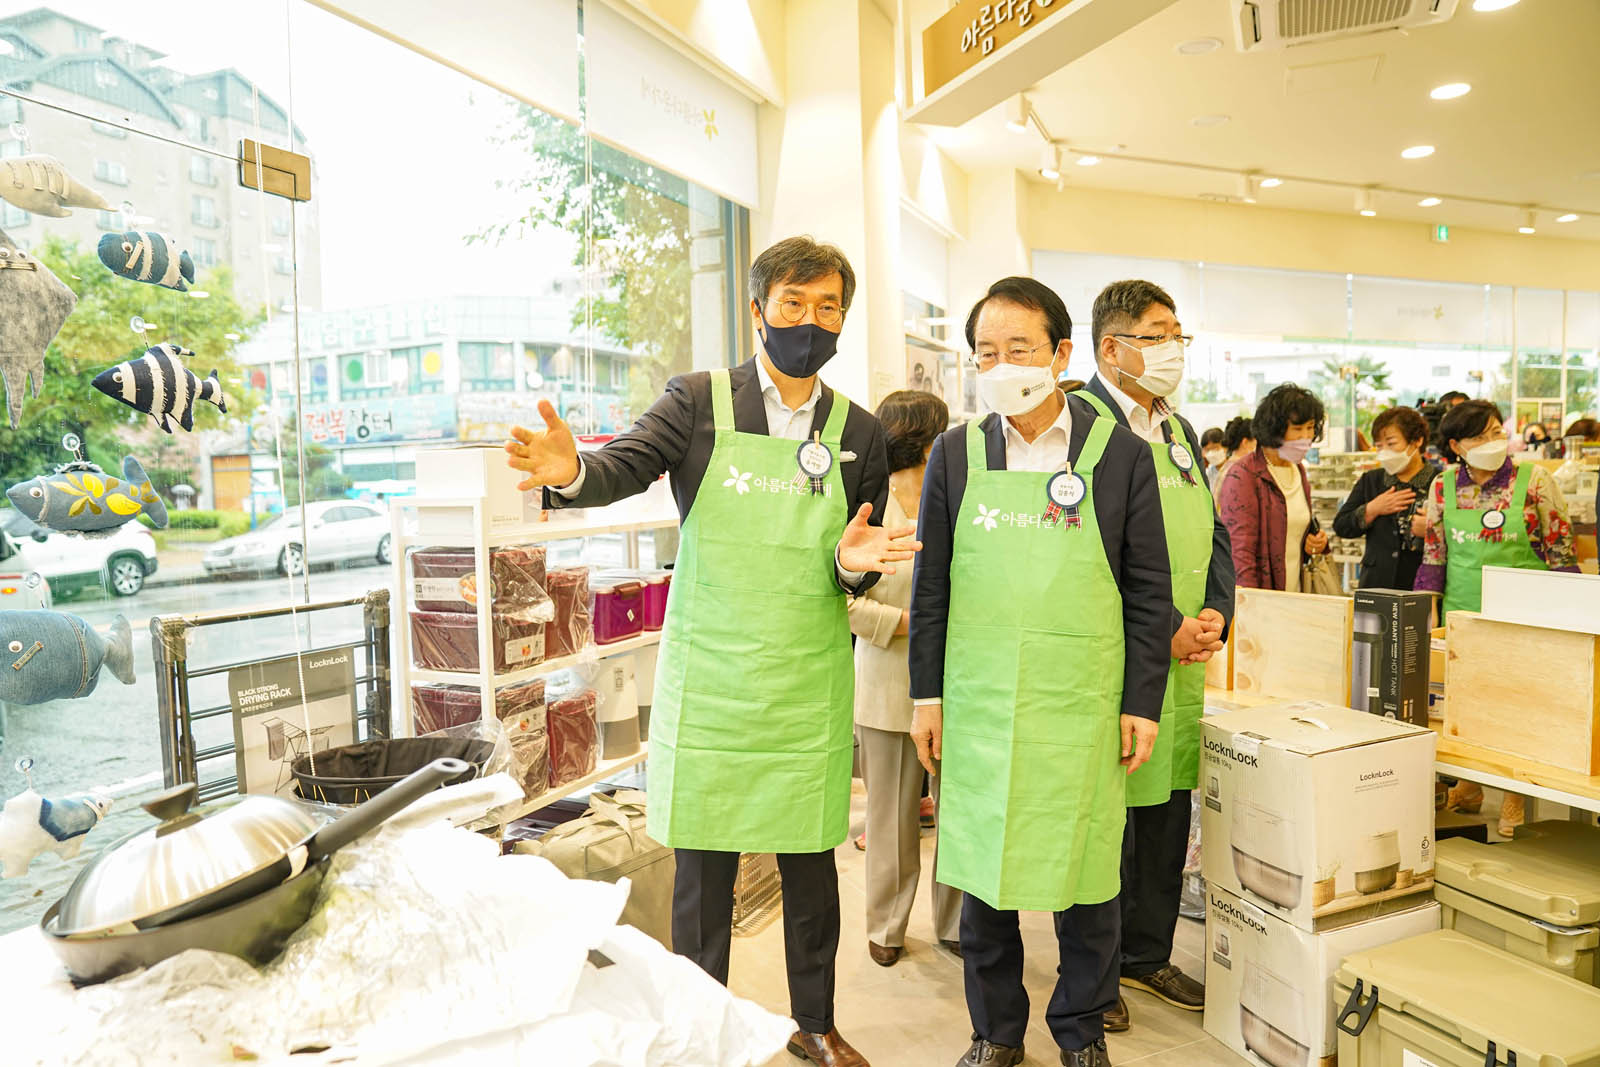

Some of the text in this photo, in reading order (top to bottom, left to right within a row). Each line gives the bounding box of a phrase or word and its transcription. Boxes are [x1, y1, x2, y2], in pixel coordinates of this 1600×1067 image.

[304, 407, 393, 442] 전복 장터
[309, 655, 348, 669] LocknLock
[237, 683, 279, 698] BLACK STRONG
[239, 687, 292, 706] DRYING RACK
[1203, 735, 1258, 768] LocknLock
[1359, 768, 1394, 782] LocknLock
[1210, 893, 1268, 936] LocknLock
